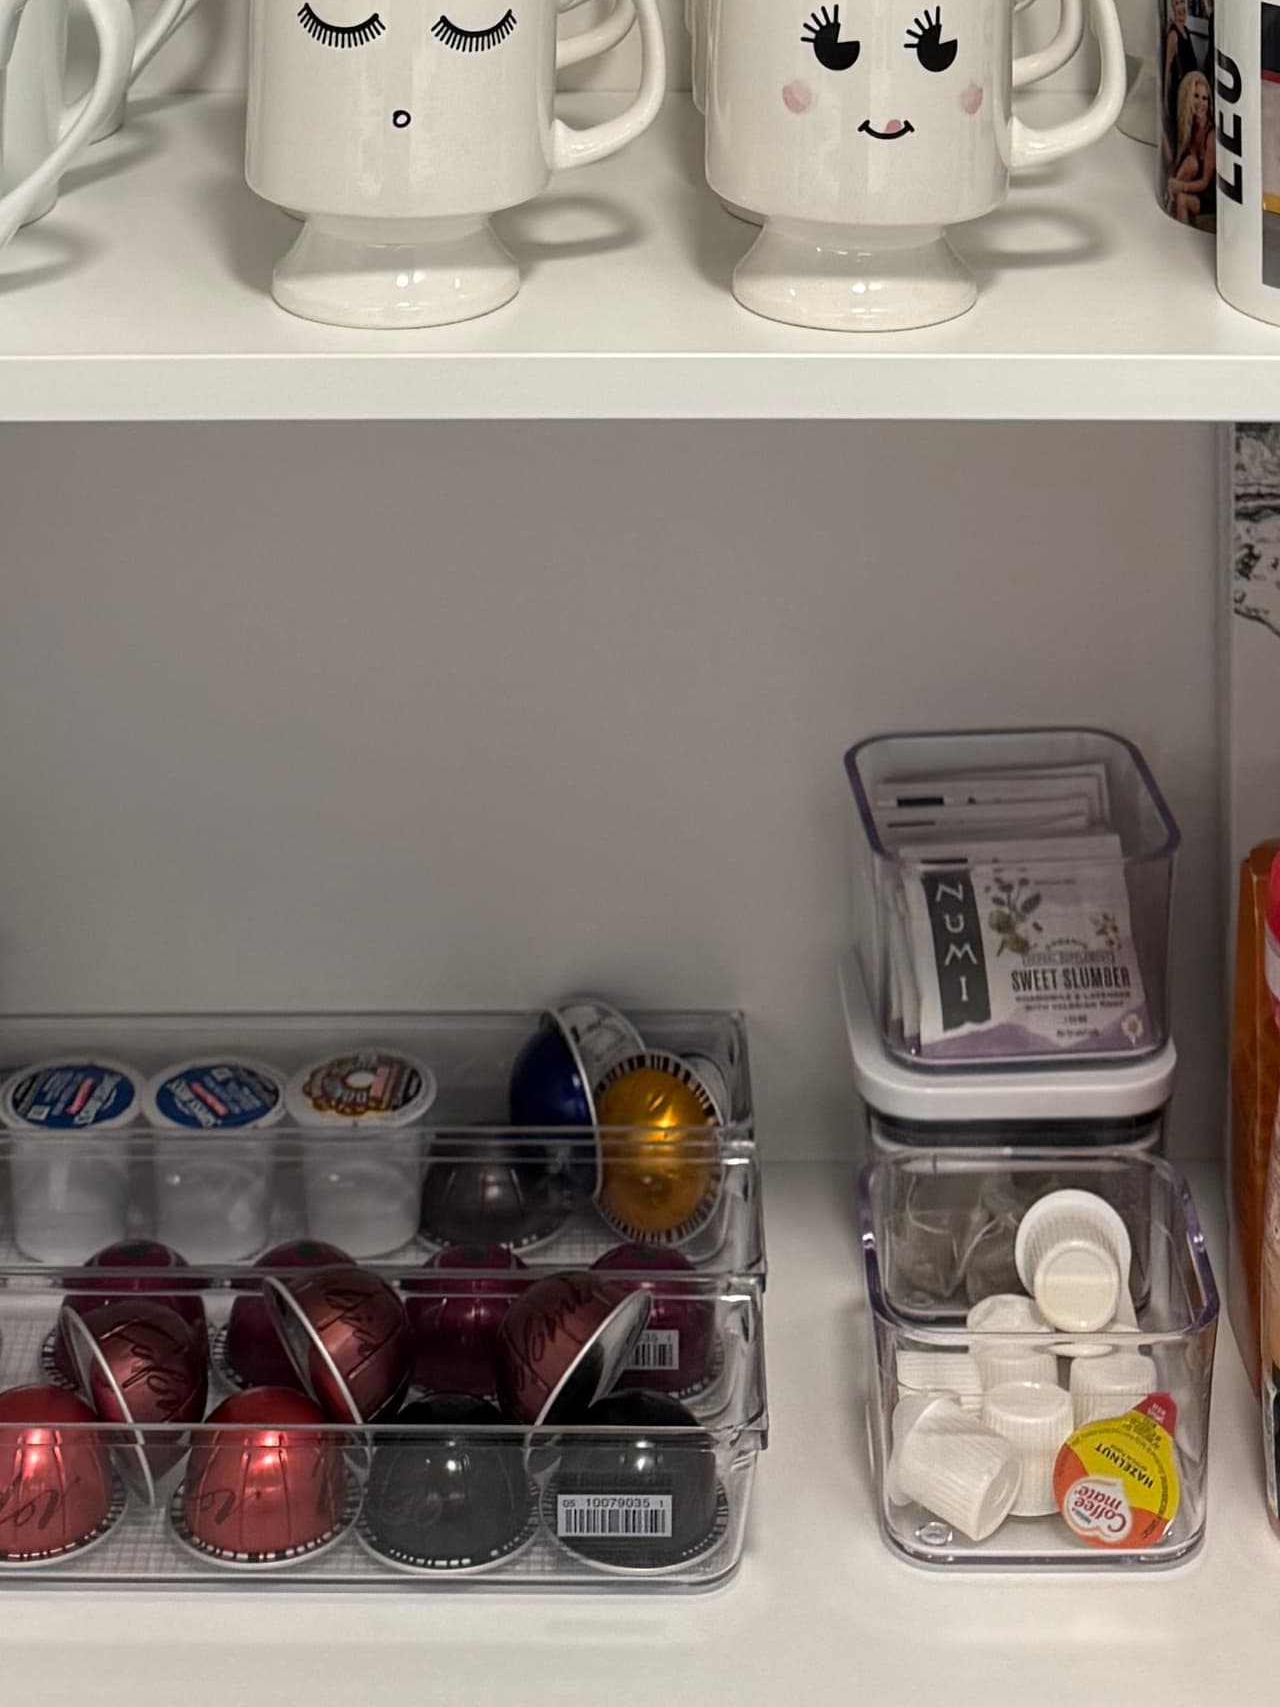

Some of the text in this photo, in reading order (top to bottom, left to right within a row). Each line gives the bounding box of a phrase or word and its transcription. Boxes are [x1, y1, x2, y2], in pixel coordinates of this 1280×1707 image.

[1217, 50, 1244, 207] LEO
[935, 882, 979, 1003] NUMI
[1011, 967, 1059, 993] SWEET
[1094, 1442, 1155, 1489] HAZELNUT
[585, 1497, 651, 1509] 10079035
[1073, 1495, 1127, 1534] Coffee
[1077, 1485, 1124, 1511] mate
